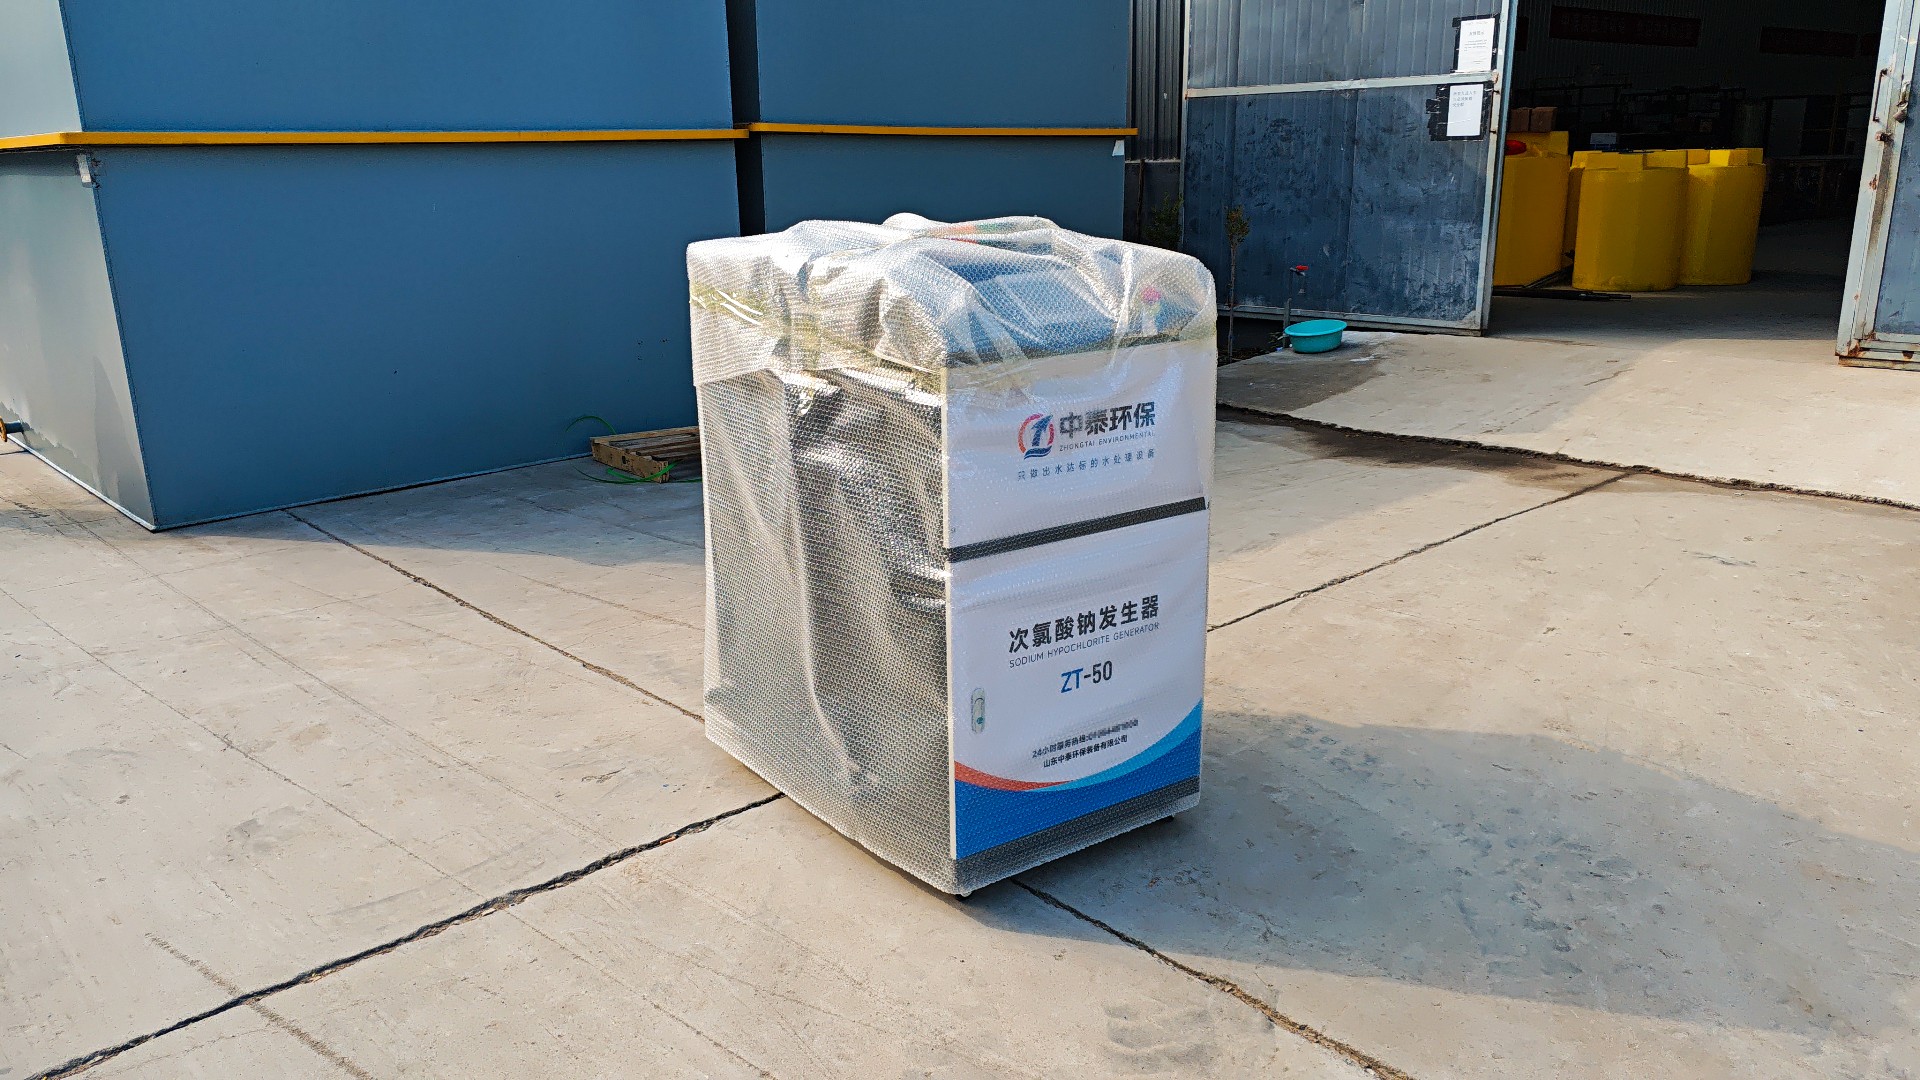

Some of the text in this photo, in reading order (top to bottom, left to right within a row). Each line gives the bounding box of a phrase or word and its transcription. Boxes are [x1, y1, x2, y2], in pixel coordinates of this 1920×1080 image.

[1059, 401, 1156, 439] 中泰环保
[1059, 431, 1156, 452] ZHONGTAI ENVIRONMENTAL
[1017, 448, 1156, 482] 只做出水达标的水处理设备
[1008, 594, 1159, 654] 次氯酸钠发生器
[1009, 622, 1160, 669] SODIUM HYPOCHLORITE GENERATOR
[1060, 660, 1113, 694] ZT-50
[1043, 734, 1128, 768] 山东中泰环保装备有限公司
